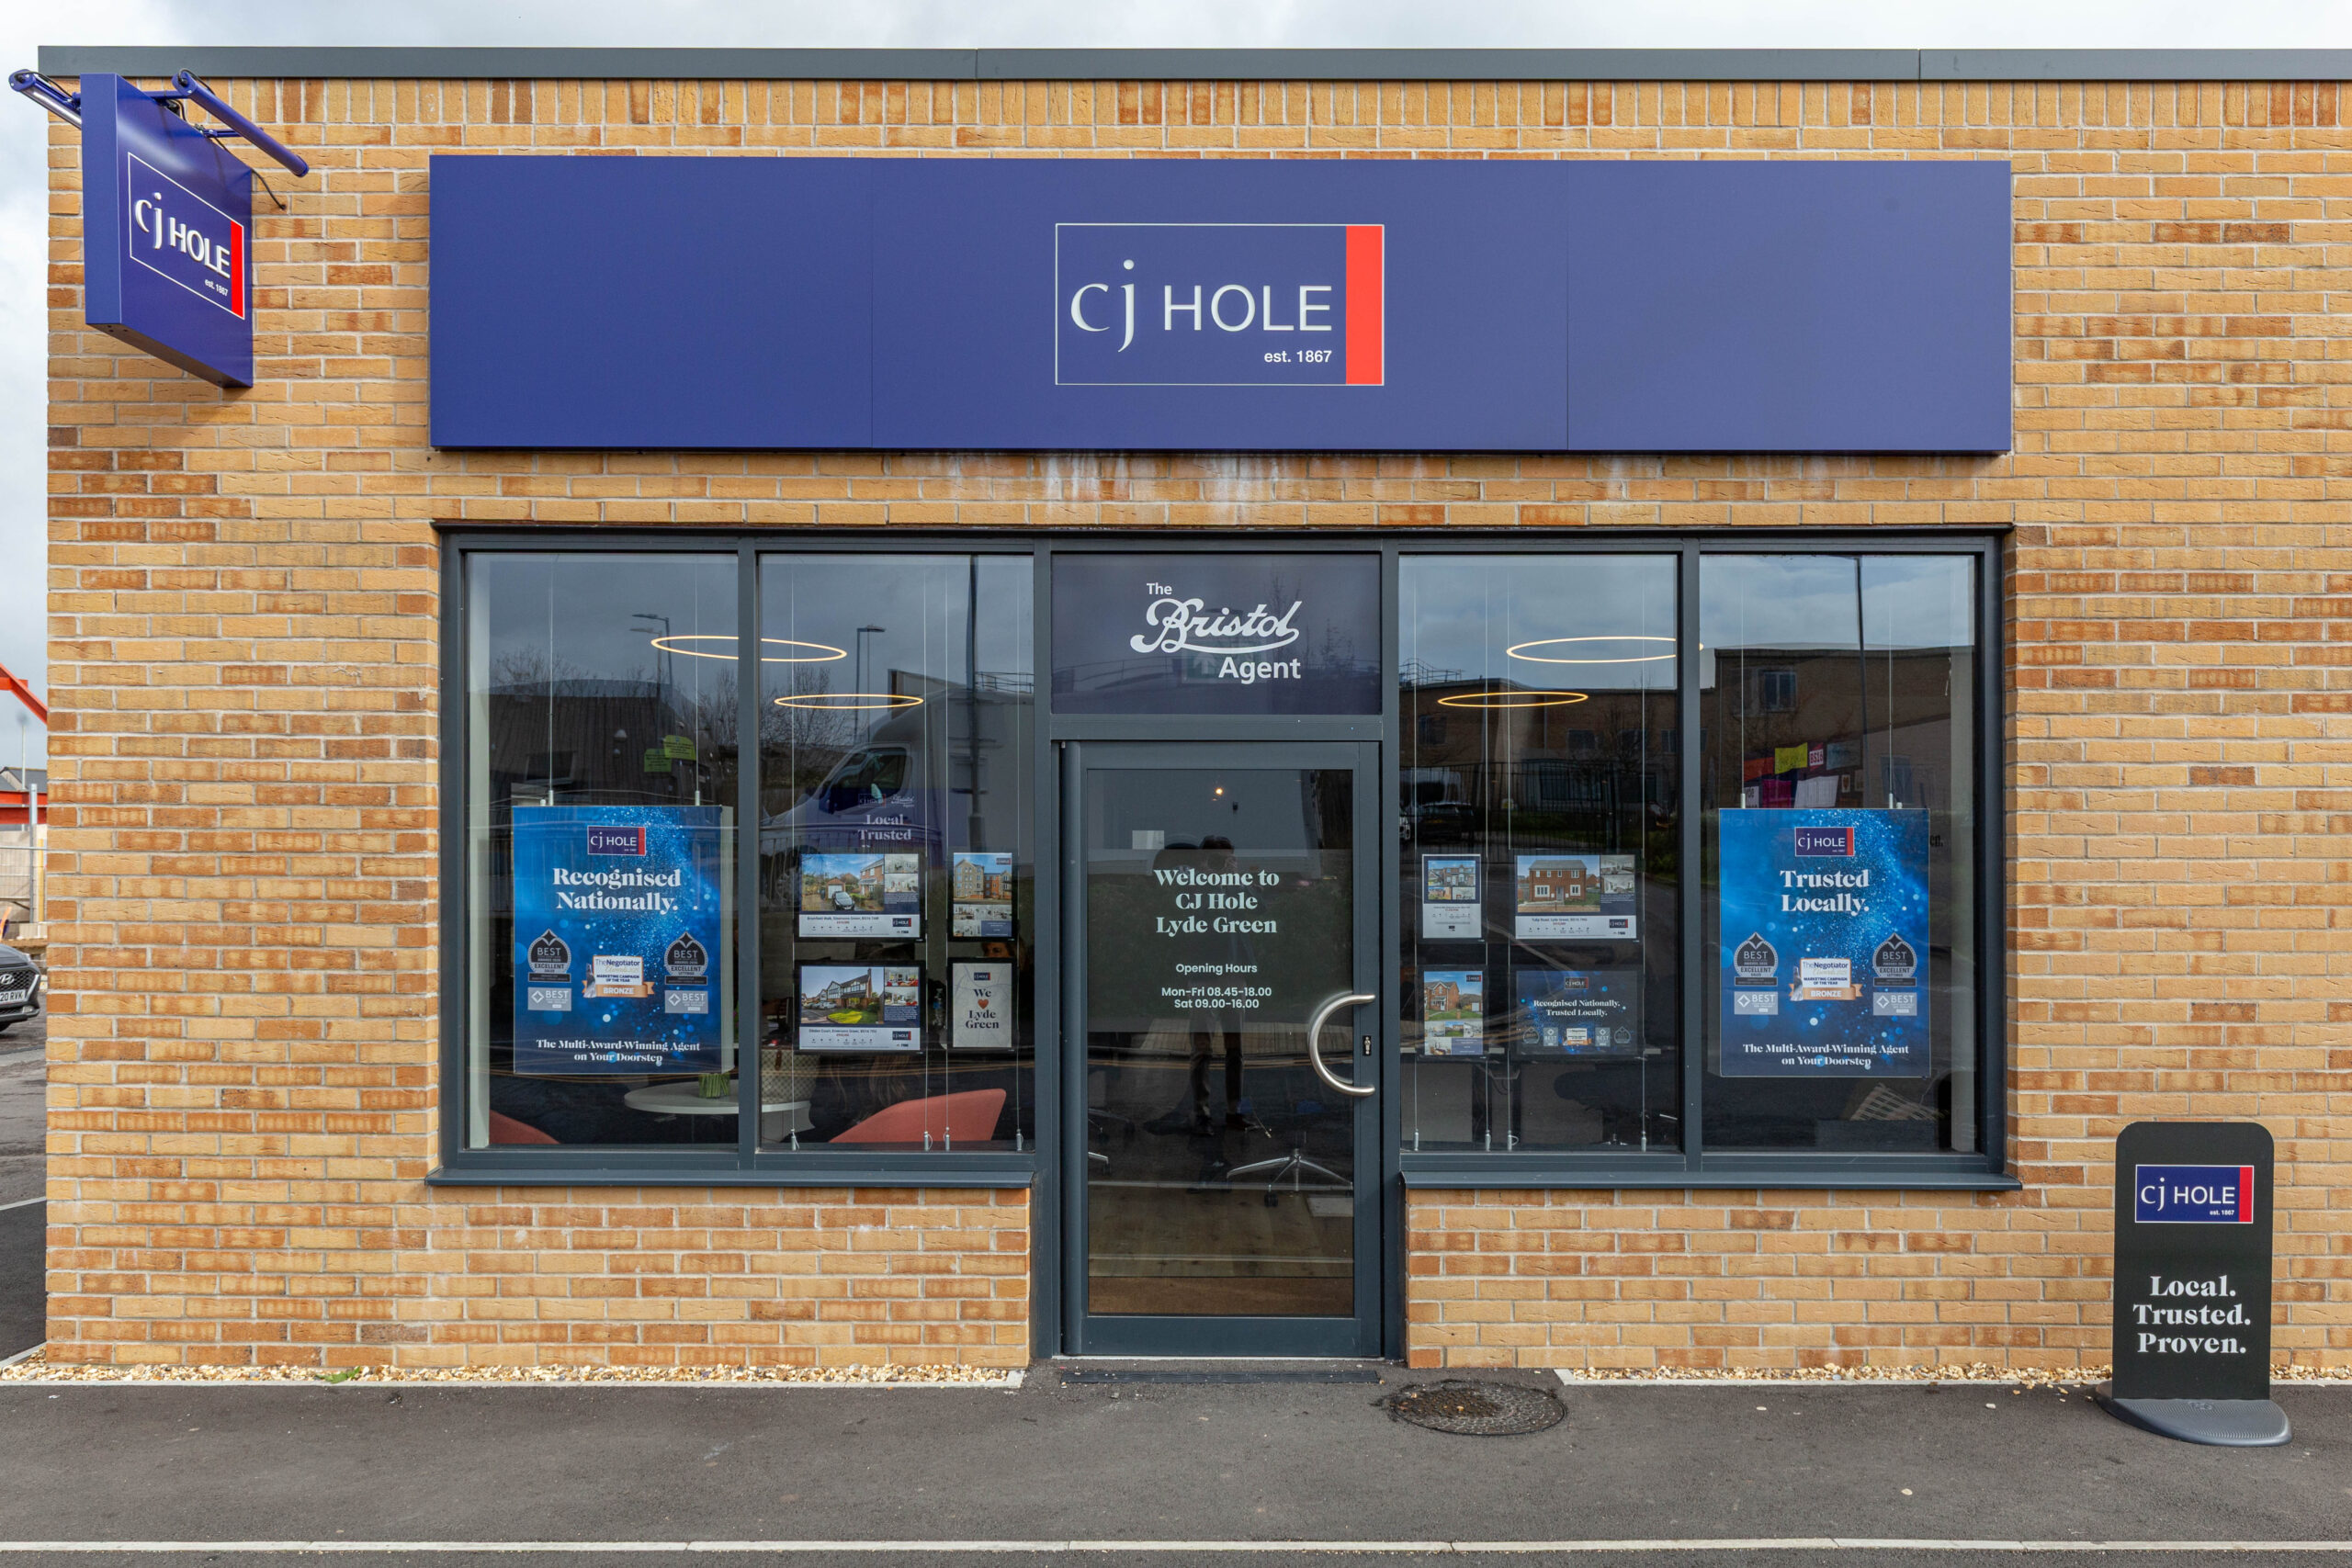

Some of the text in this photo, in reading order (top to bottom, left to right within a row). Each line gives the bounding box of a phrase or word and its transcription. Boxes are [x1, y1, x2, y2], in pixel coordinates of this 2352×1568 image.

[169, 217, 232, 279] HOLE
[205, 278, 229, 296] est. 1867
[1070, 259, 1332, 353] cj HOLE
[1264, 350, 1332, 363] est. 1867
[1147, 582, 1172, 595] The
[1130, 598, 1303, 654] Bristol
[1218, 657, 1302, 684] Agent
[1810, 750, 1824, 764] BS16
[865, 814, 904, 825] Local
[858, 829, 911, 840] Trusted
[606, 837, 637, 847] HOLE
[1814, 837, 1846, 847] HOLE
[553, 868, 681, 889] Recognised
[1153, 868, 1280, 886] Welcome to
[1780, 869, 1870, 888] Trusted
[556, 891, 679, 915] Nationally.
[1175, 892, 1258, 909] CJ Hole
[1781, 894, 1870, 916] Locally.
[1156, 915, 1277, 937] Lyde Green
[537, 947, 561, 956] BEST
[673, 950, 698, 959] BEST
[1744, 951, 1769, 960] BEST
[1883, 952, 1907, 960] BEST
[1175, 963, 1258, 976] Opening Hours
[545, 990, 569, 998] BEST
[682, 993, 706, 1001] BEST
[973, 988, 991, 998] We
[1161, 987, 1272, 997] Mon-Fri 08.45-18.00
[1751, 994, 1776, 1003] BEST
[1174, 999, 1260, 1009] Sat 09.00-16.00
[1533, 999, 1621, 1009] Recognised Nationally.
[1891, 995, 1914, 1003] BEST
[969, 1010, 996, 1021] Lyde
[1577, 1009, 1608, 1017] Locally.
[966, 1020, 1000, 1029] Green
[537, 1039, 700, 1053] The Multi-Award-Winning Agent
[1743, 1043, 1909, 1055] The Multi-Award-Winning Agent
[574, 1052, 663, 1065] on Your Doorstep
[1781, 1055, 1871, 1067] on Your Doorstep
[2141, 1177, 2235, 1212] cj HOLE
[2149, 1275, 2236, 1297] Local.
[2132, 1303, 2251, 1325] Trusted.
[2137, 1332, 2246, 1354] Proven.
